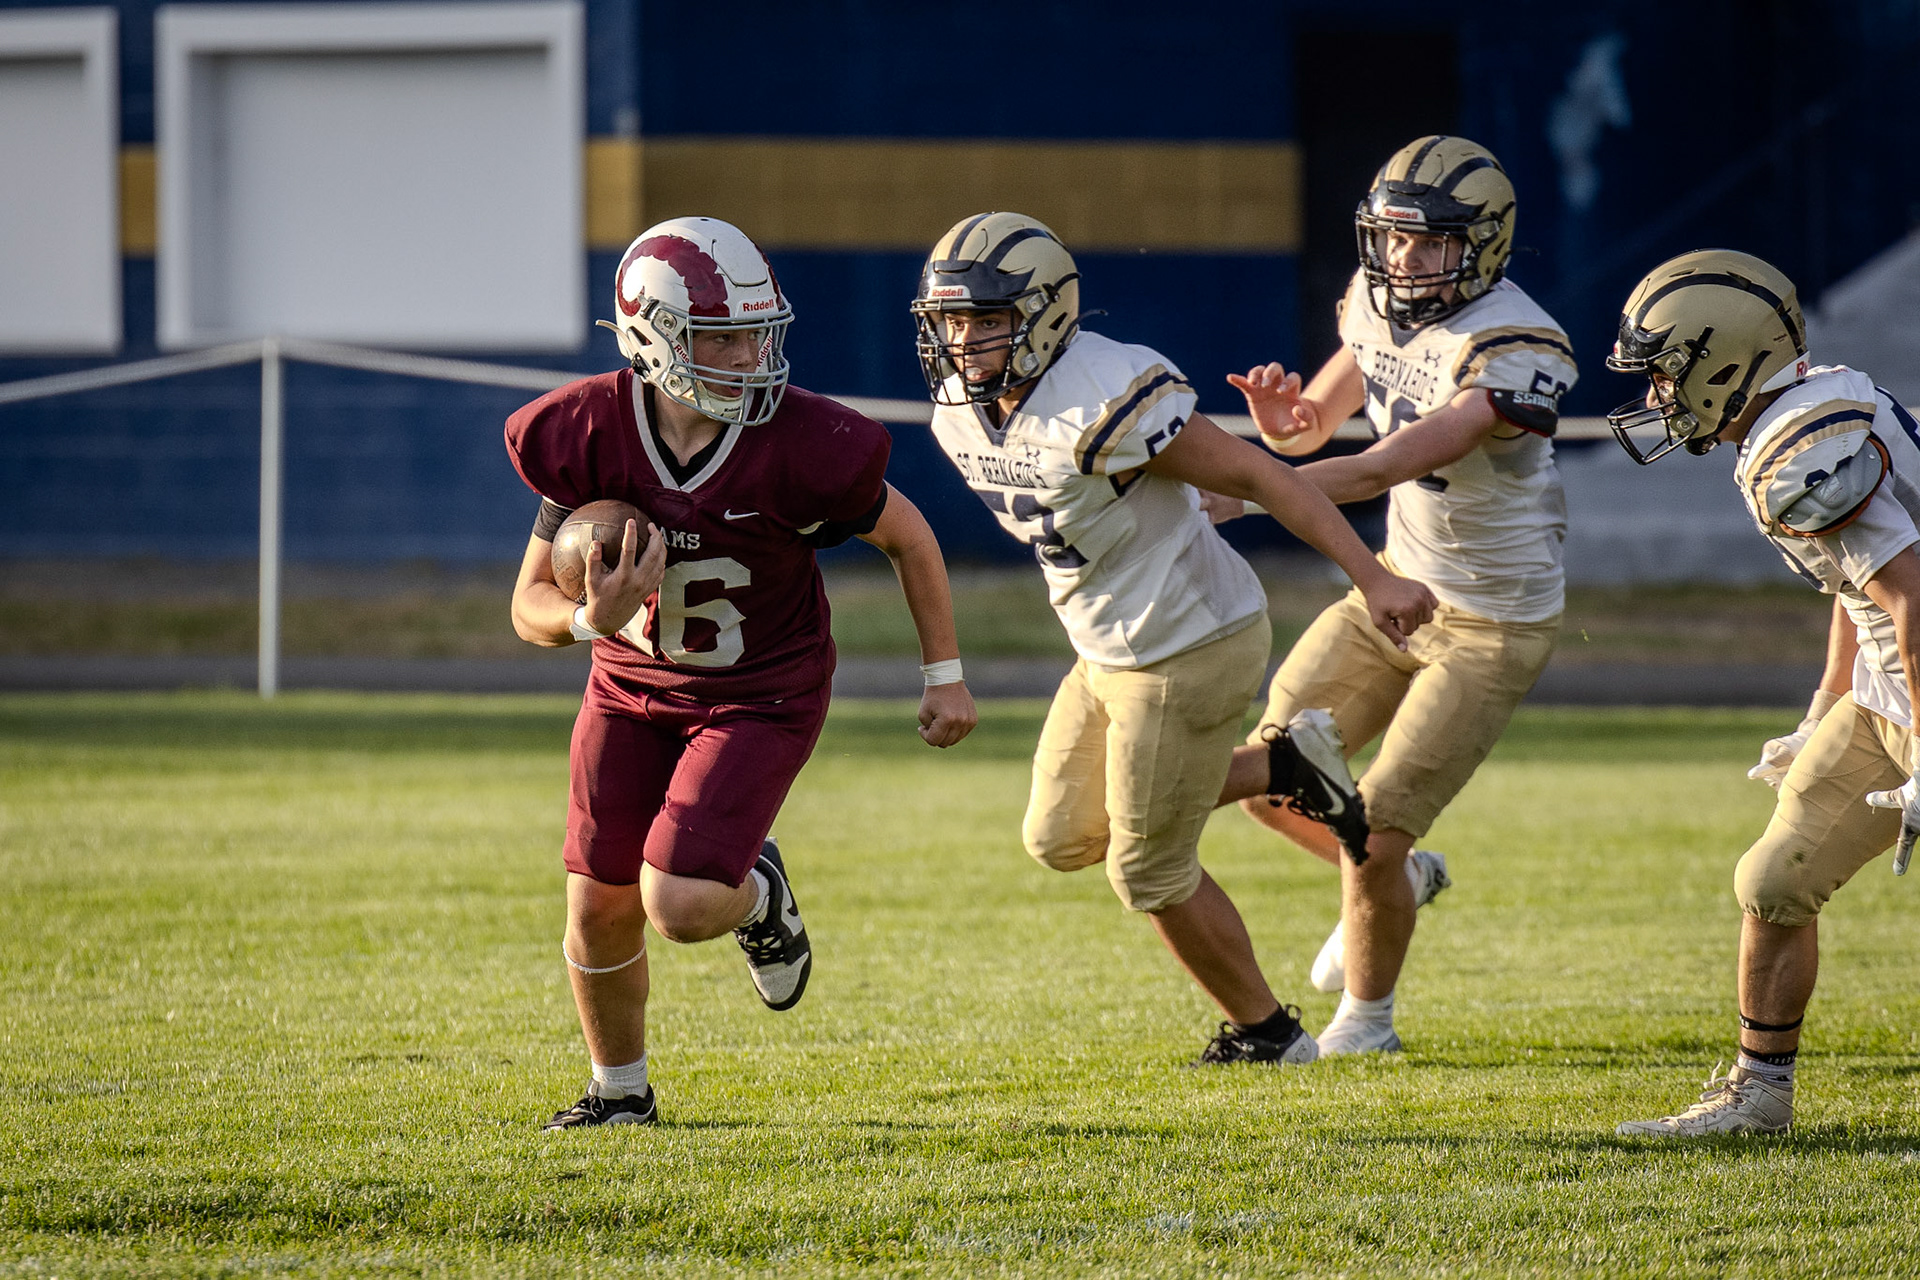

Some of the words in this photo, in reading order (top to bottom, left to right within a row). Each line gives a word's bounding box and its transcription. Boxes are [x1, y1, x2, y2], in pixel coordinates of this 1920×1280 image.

[742, 299, 775, 312] Riddell
[1372, 350, 1438, 406] BERNARD'S
[957, 453, 980, 482] ST.
[977, 455, 1049, 489] BERNARD'S
[660, 526, 701, 550] AMS
